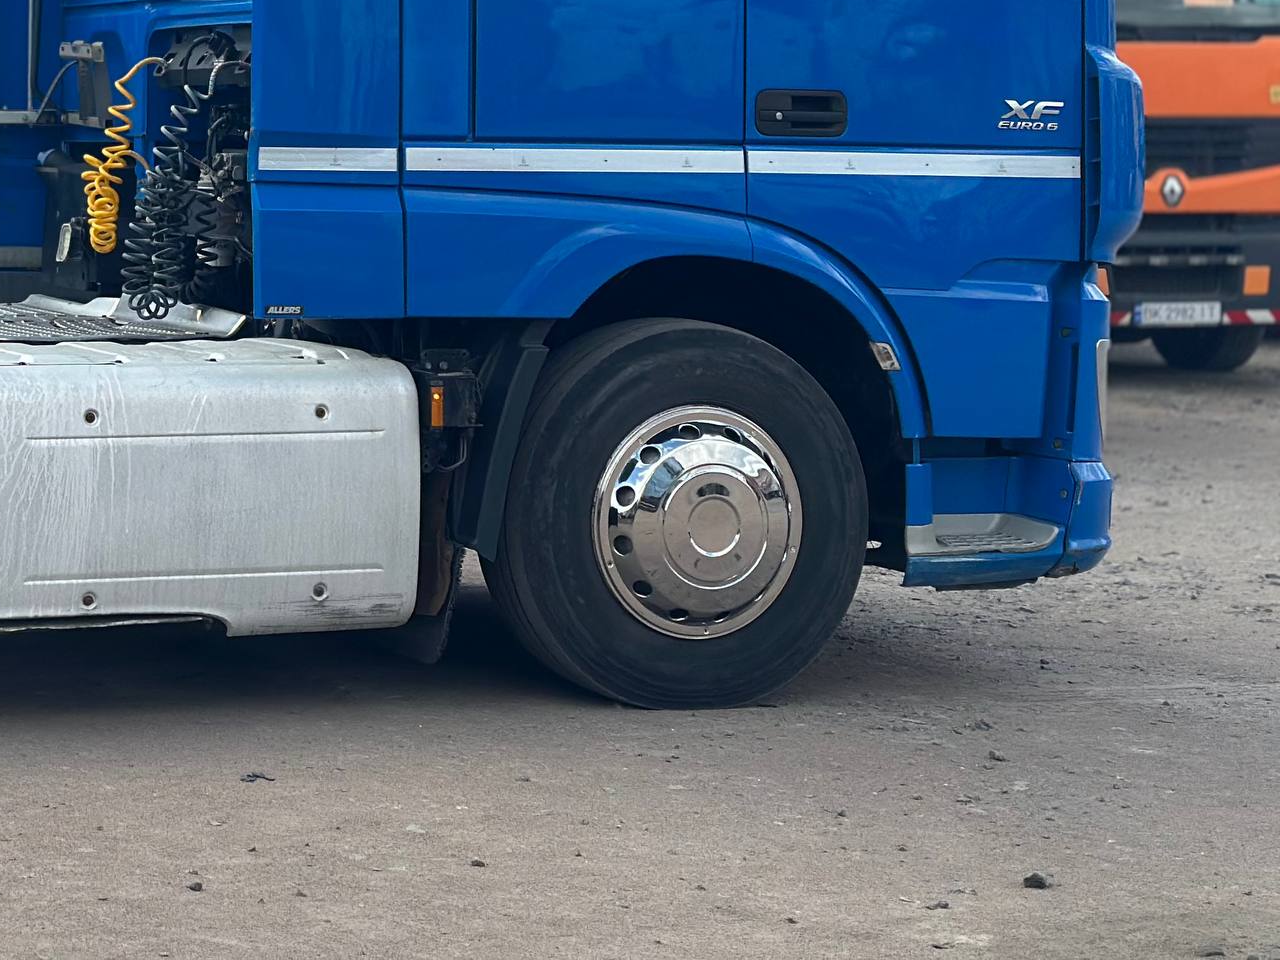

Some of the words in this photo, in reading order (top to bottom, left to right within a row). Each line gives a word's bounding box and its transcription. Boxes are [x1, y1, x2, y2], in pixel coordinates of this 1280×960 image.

[1001, 100, 1064, 119] XF
[998, 121, 1044, 131] EURO
[1047, 122, 1058, 131] 6
[267, 306, 301, 314] ALLERS
